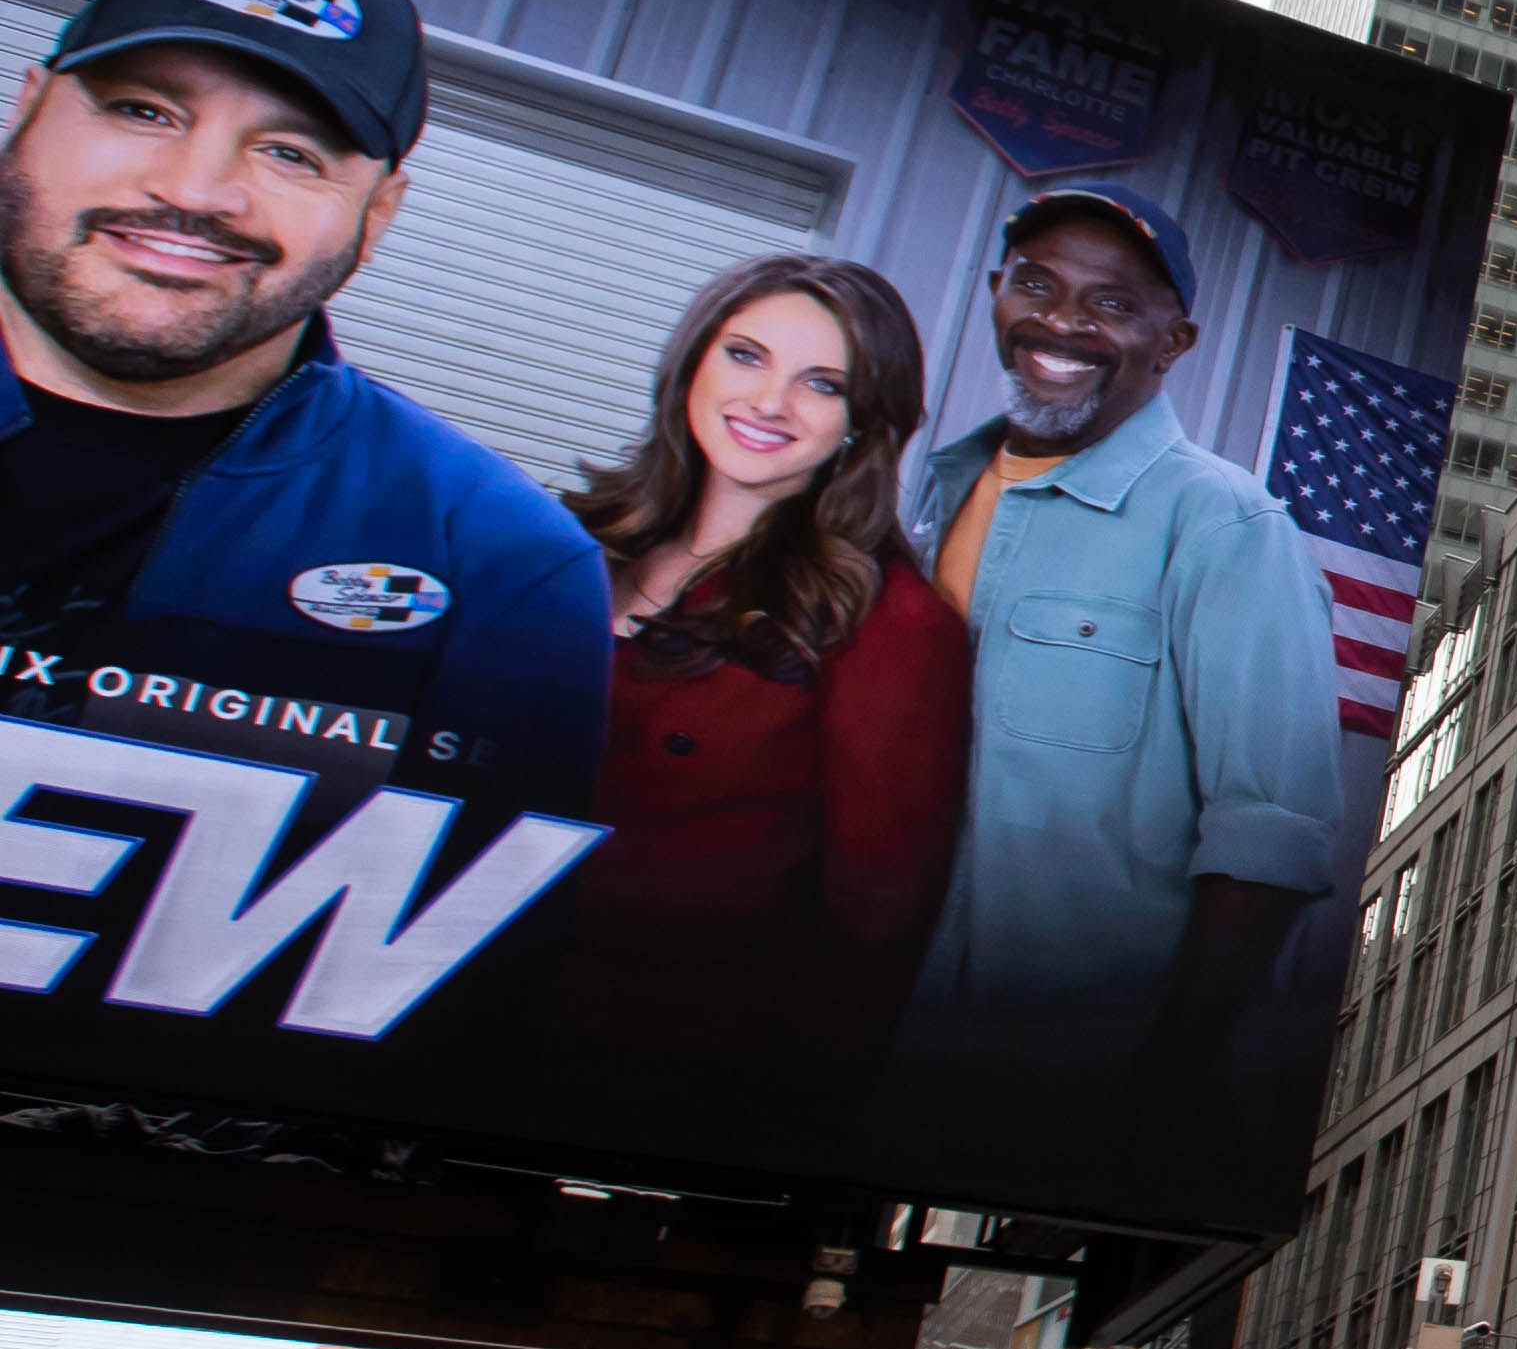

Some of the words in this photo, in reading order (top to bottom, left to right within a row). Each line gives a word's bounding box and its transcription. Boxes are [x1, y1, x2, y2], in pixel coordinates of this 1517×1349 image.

[977, 14, 1156, 108] FAME
[985, 63, 1127, 123] CHARLOTTE
[1246, 135, 1306, 174] PIT
[1313, 159, 1416, 207] CREW
[1255, 111, 1421, 181] VALUABLE
[87, 665, 400, 751] ORIGINAL
